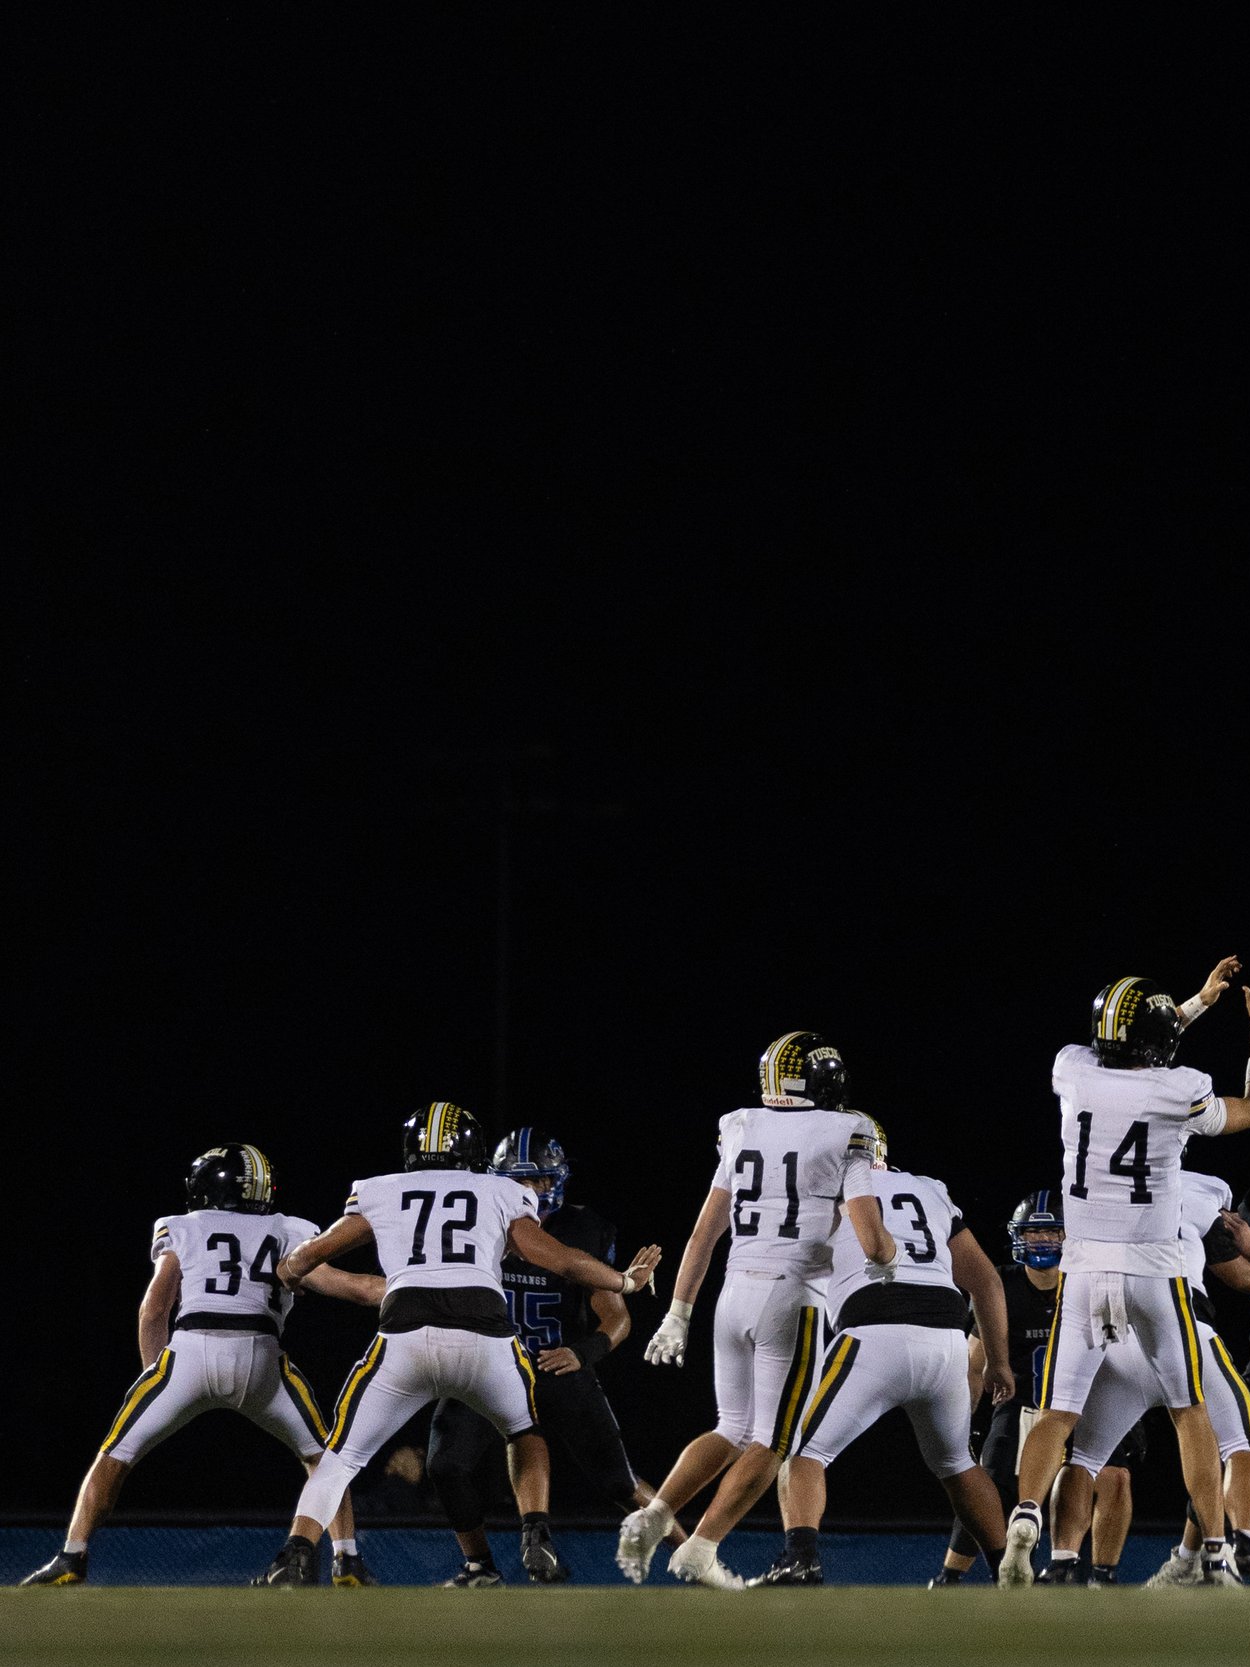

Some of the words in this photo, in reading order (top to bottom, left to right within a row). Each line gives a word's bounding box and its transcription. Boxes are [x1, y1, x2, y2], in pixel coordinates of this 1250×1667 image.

[421, 1153, 446, 1162] VICIS
[1069, 1110, 1153, 1204] 14
[401, 1190, 478, 1265] 72
[733, 1149, 800, 1239] 21
[876, 1193, 937, 1264] 3
[205, 1232, 281, 1310] 34
[502, 1273, 548, 1287] USTANGS
[1101, 1323, 1118, 1340] T
